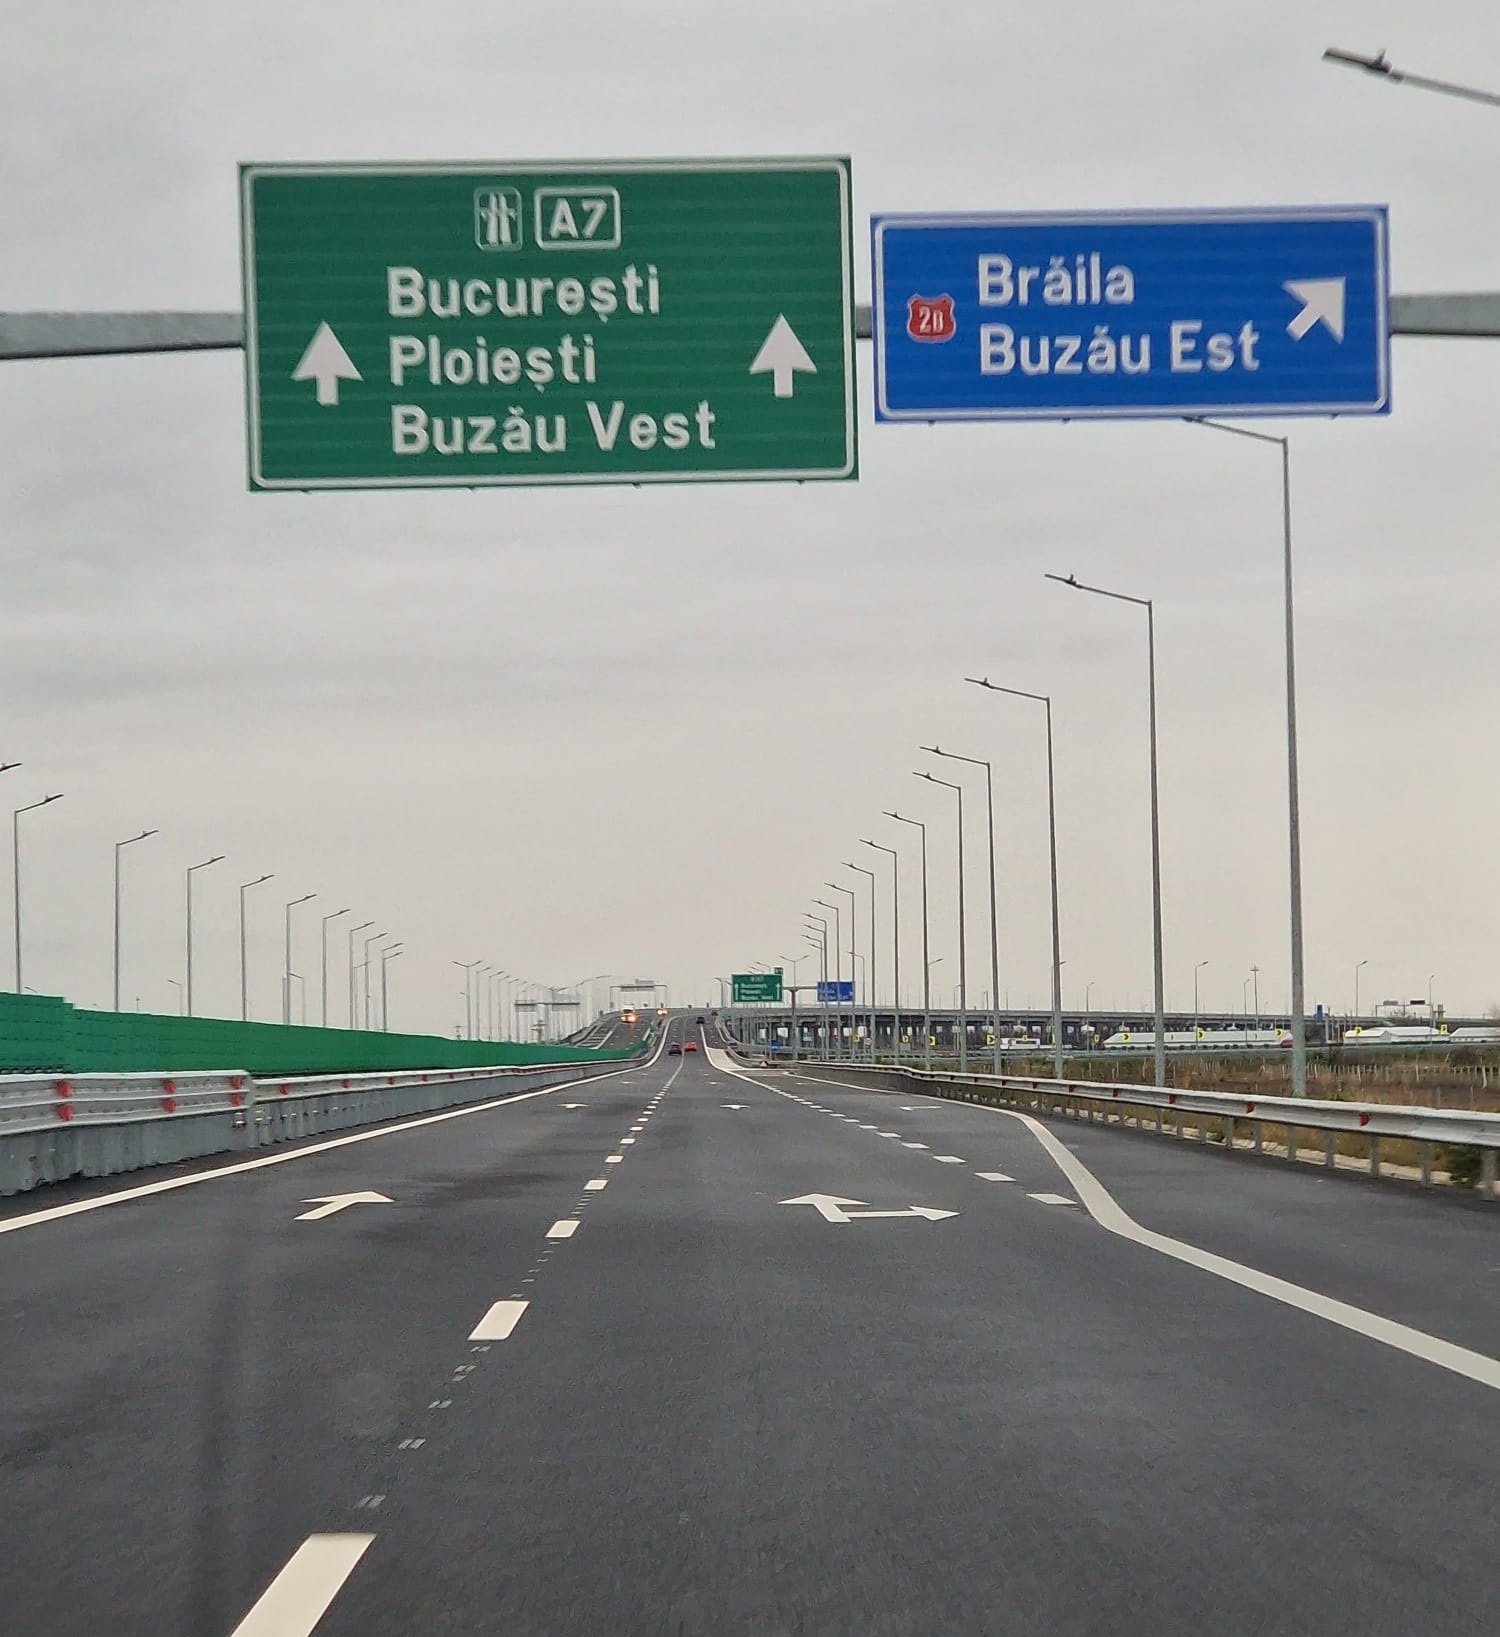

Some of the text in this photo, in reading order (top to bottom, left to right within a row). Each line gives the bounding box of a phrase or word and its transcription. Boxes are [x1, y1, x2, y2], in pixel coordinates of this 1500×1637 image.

[550, 199, 607, 237] A7
[387, 265, 660, 323] București
[978, 253, 1135, 305] Brăila
[390, 335, 596, 392] Ploiești
[980, 321, 1260, 375] Buzău Est
[391, 401, 716, 454] Buzău Vest
